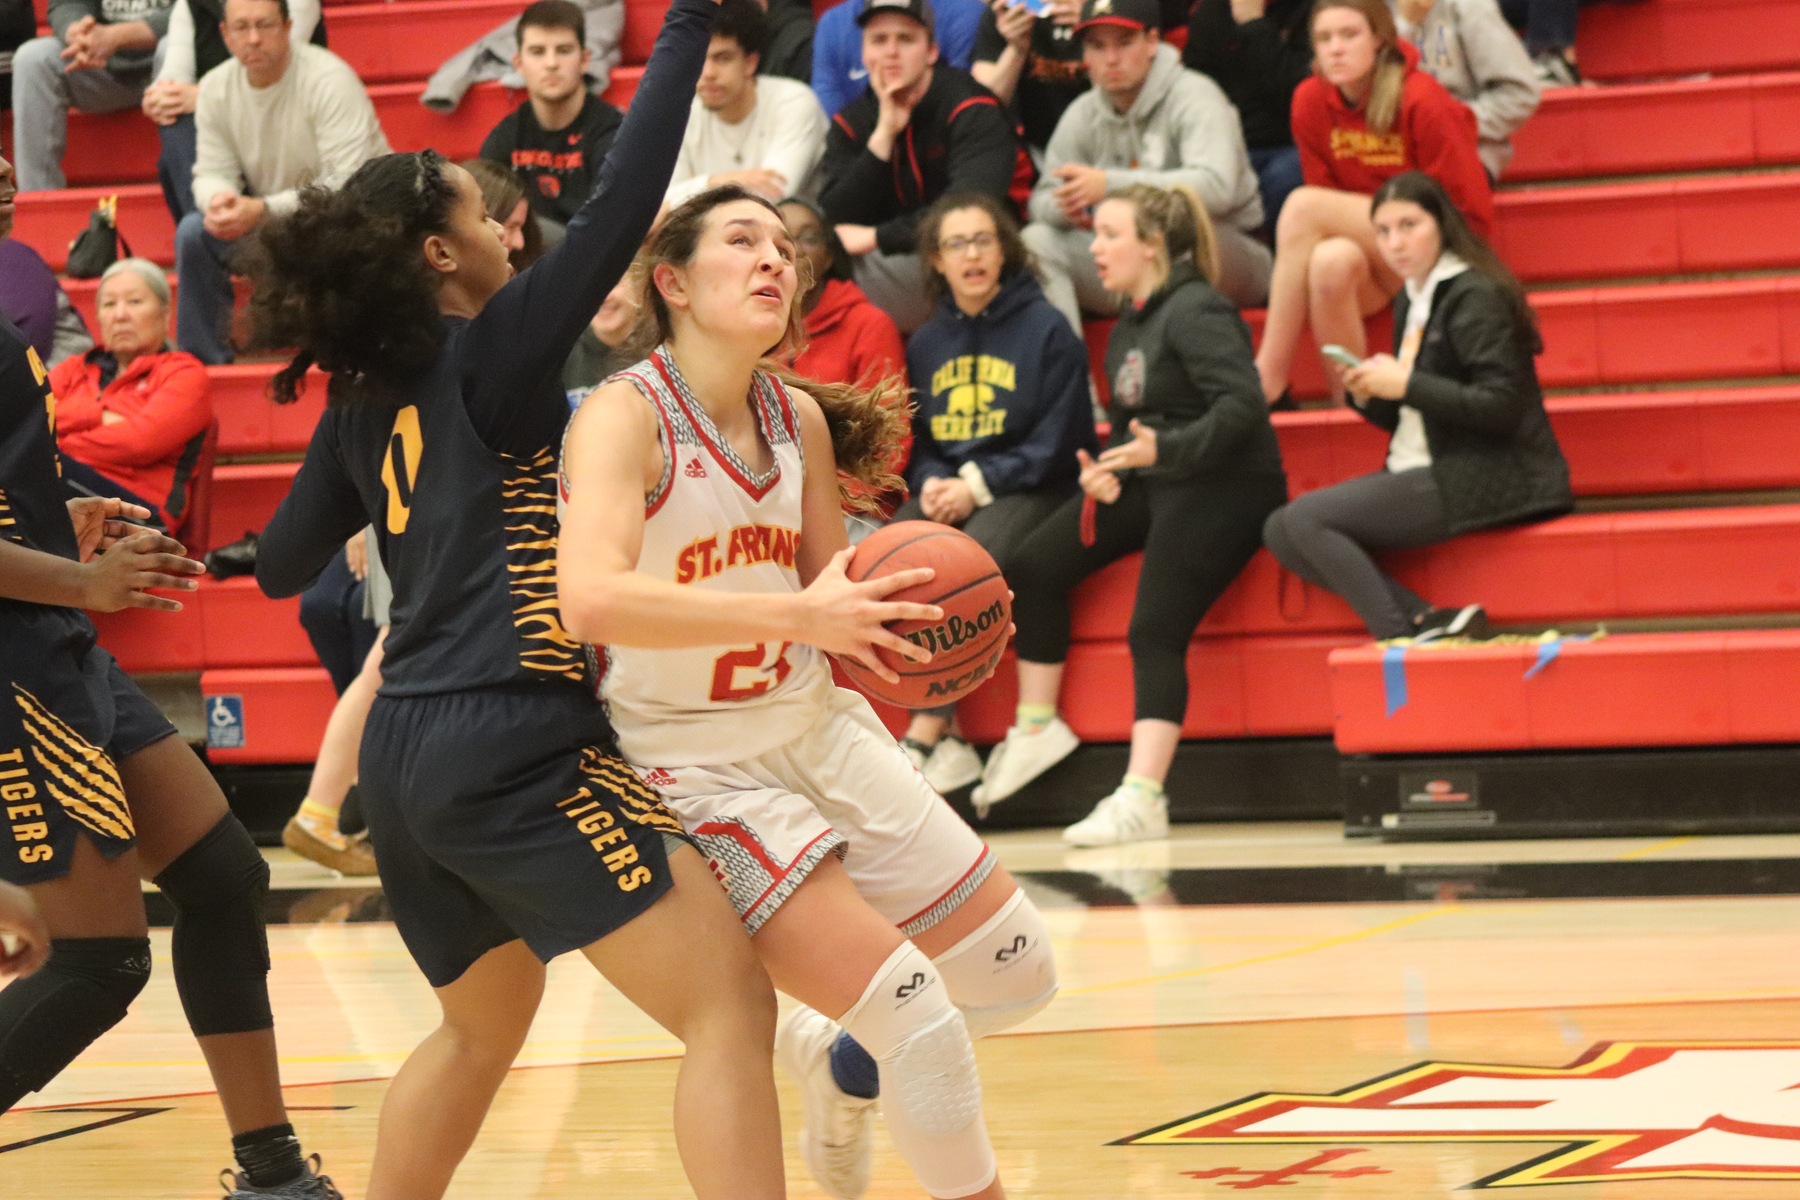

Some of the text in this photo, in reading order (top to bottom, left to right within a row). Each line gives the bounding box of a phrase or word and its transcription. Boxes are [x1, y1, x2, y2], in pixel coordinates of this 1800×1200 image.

[931, 354, 1016, 397] CALIFRNIA
[930, 408, 1008, 442] BERKLEY
[674, 531, 723, 586] ST.
[901, 598, 1004, 663] Wilson
[0, 747, 54, 864] TIGERS
[555, 786, 652, 892] TIGERS
